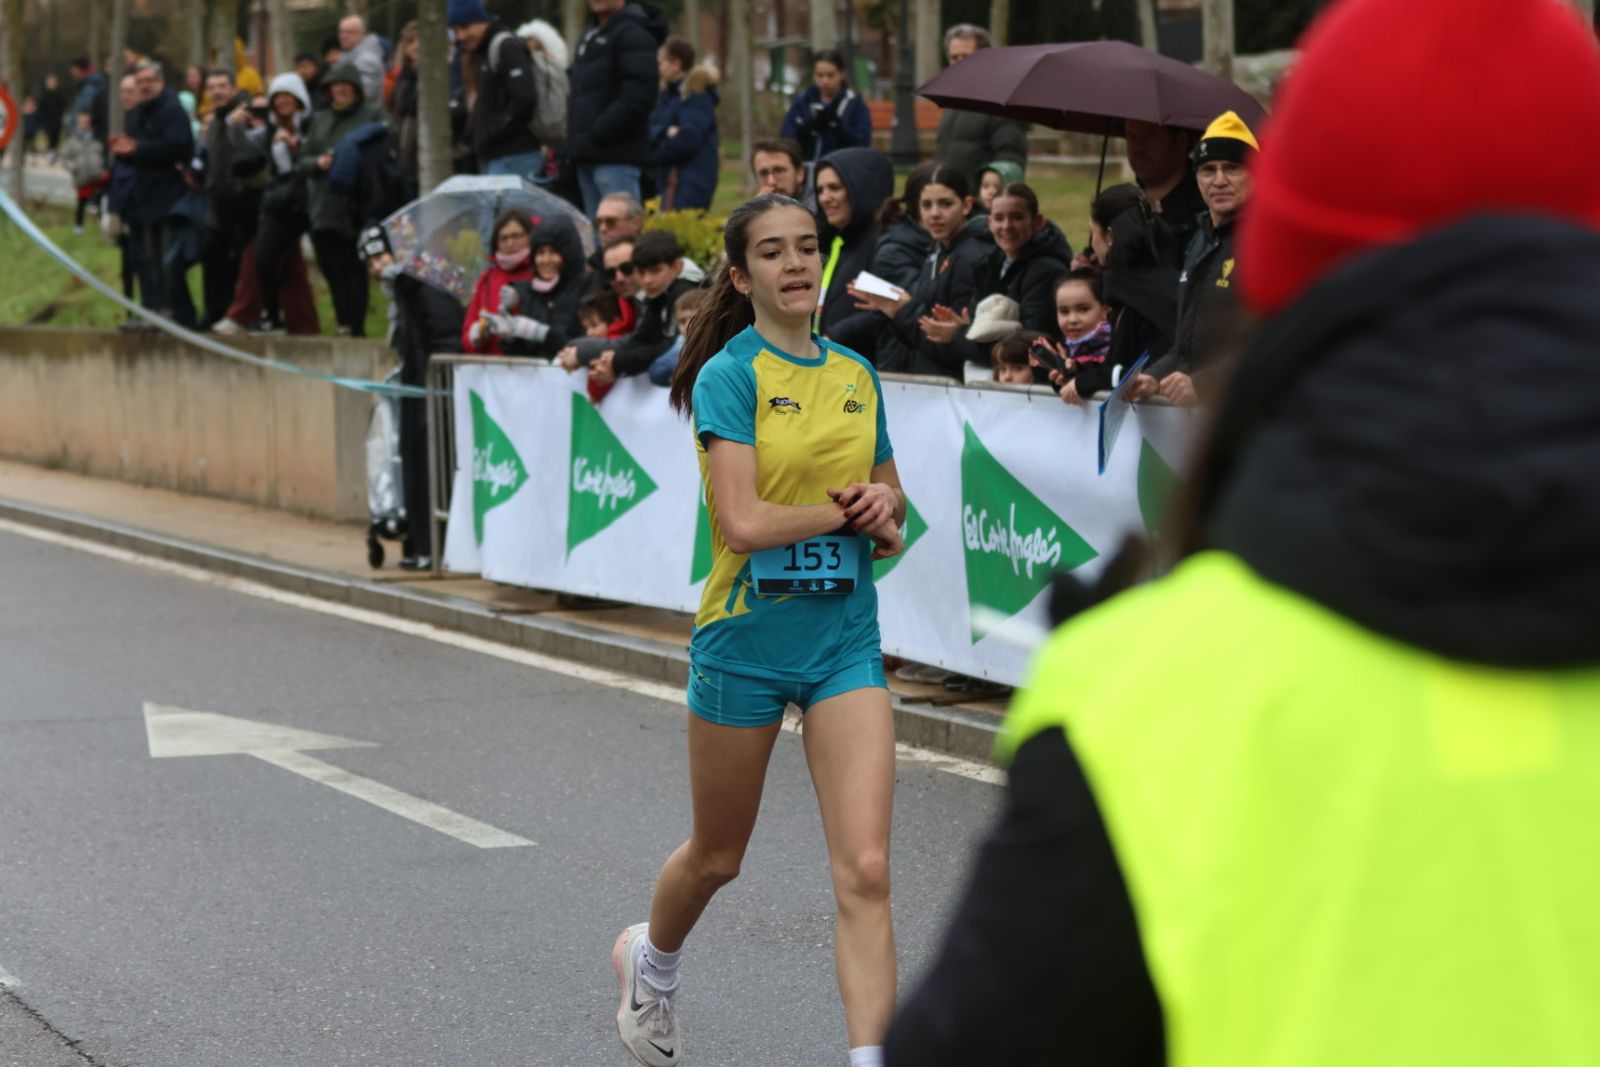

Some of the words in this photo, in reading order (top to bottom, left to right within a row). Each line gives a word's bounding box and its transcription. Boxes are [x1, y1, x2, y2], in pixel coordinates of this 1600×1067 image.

[784, 542, 841, 571] 153
[963, 504, 981, 553] El
[979, 508, 1010, 557] Corte
[1008, 502, 1062, 580] Inglés
